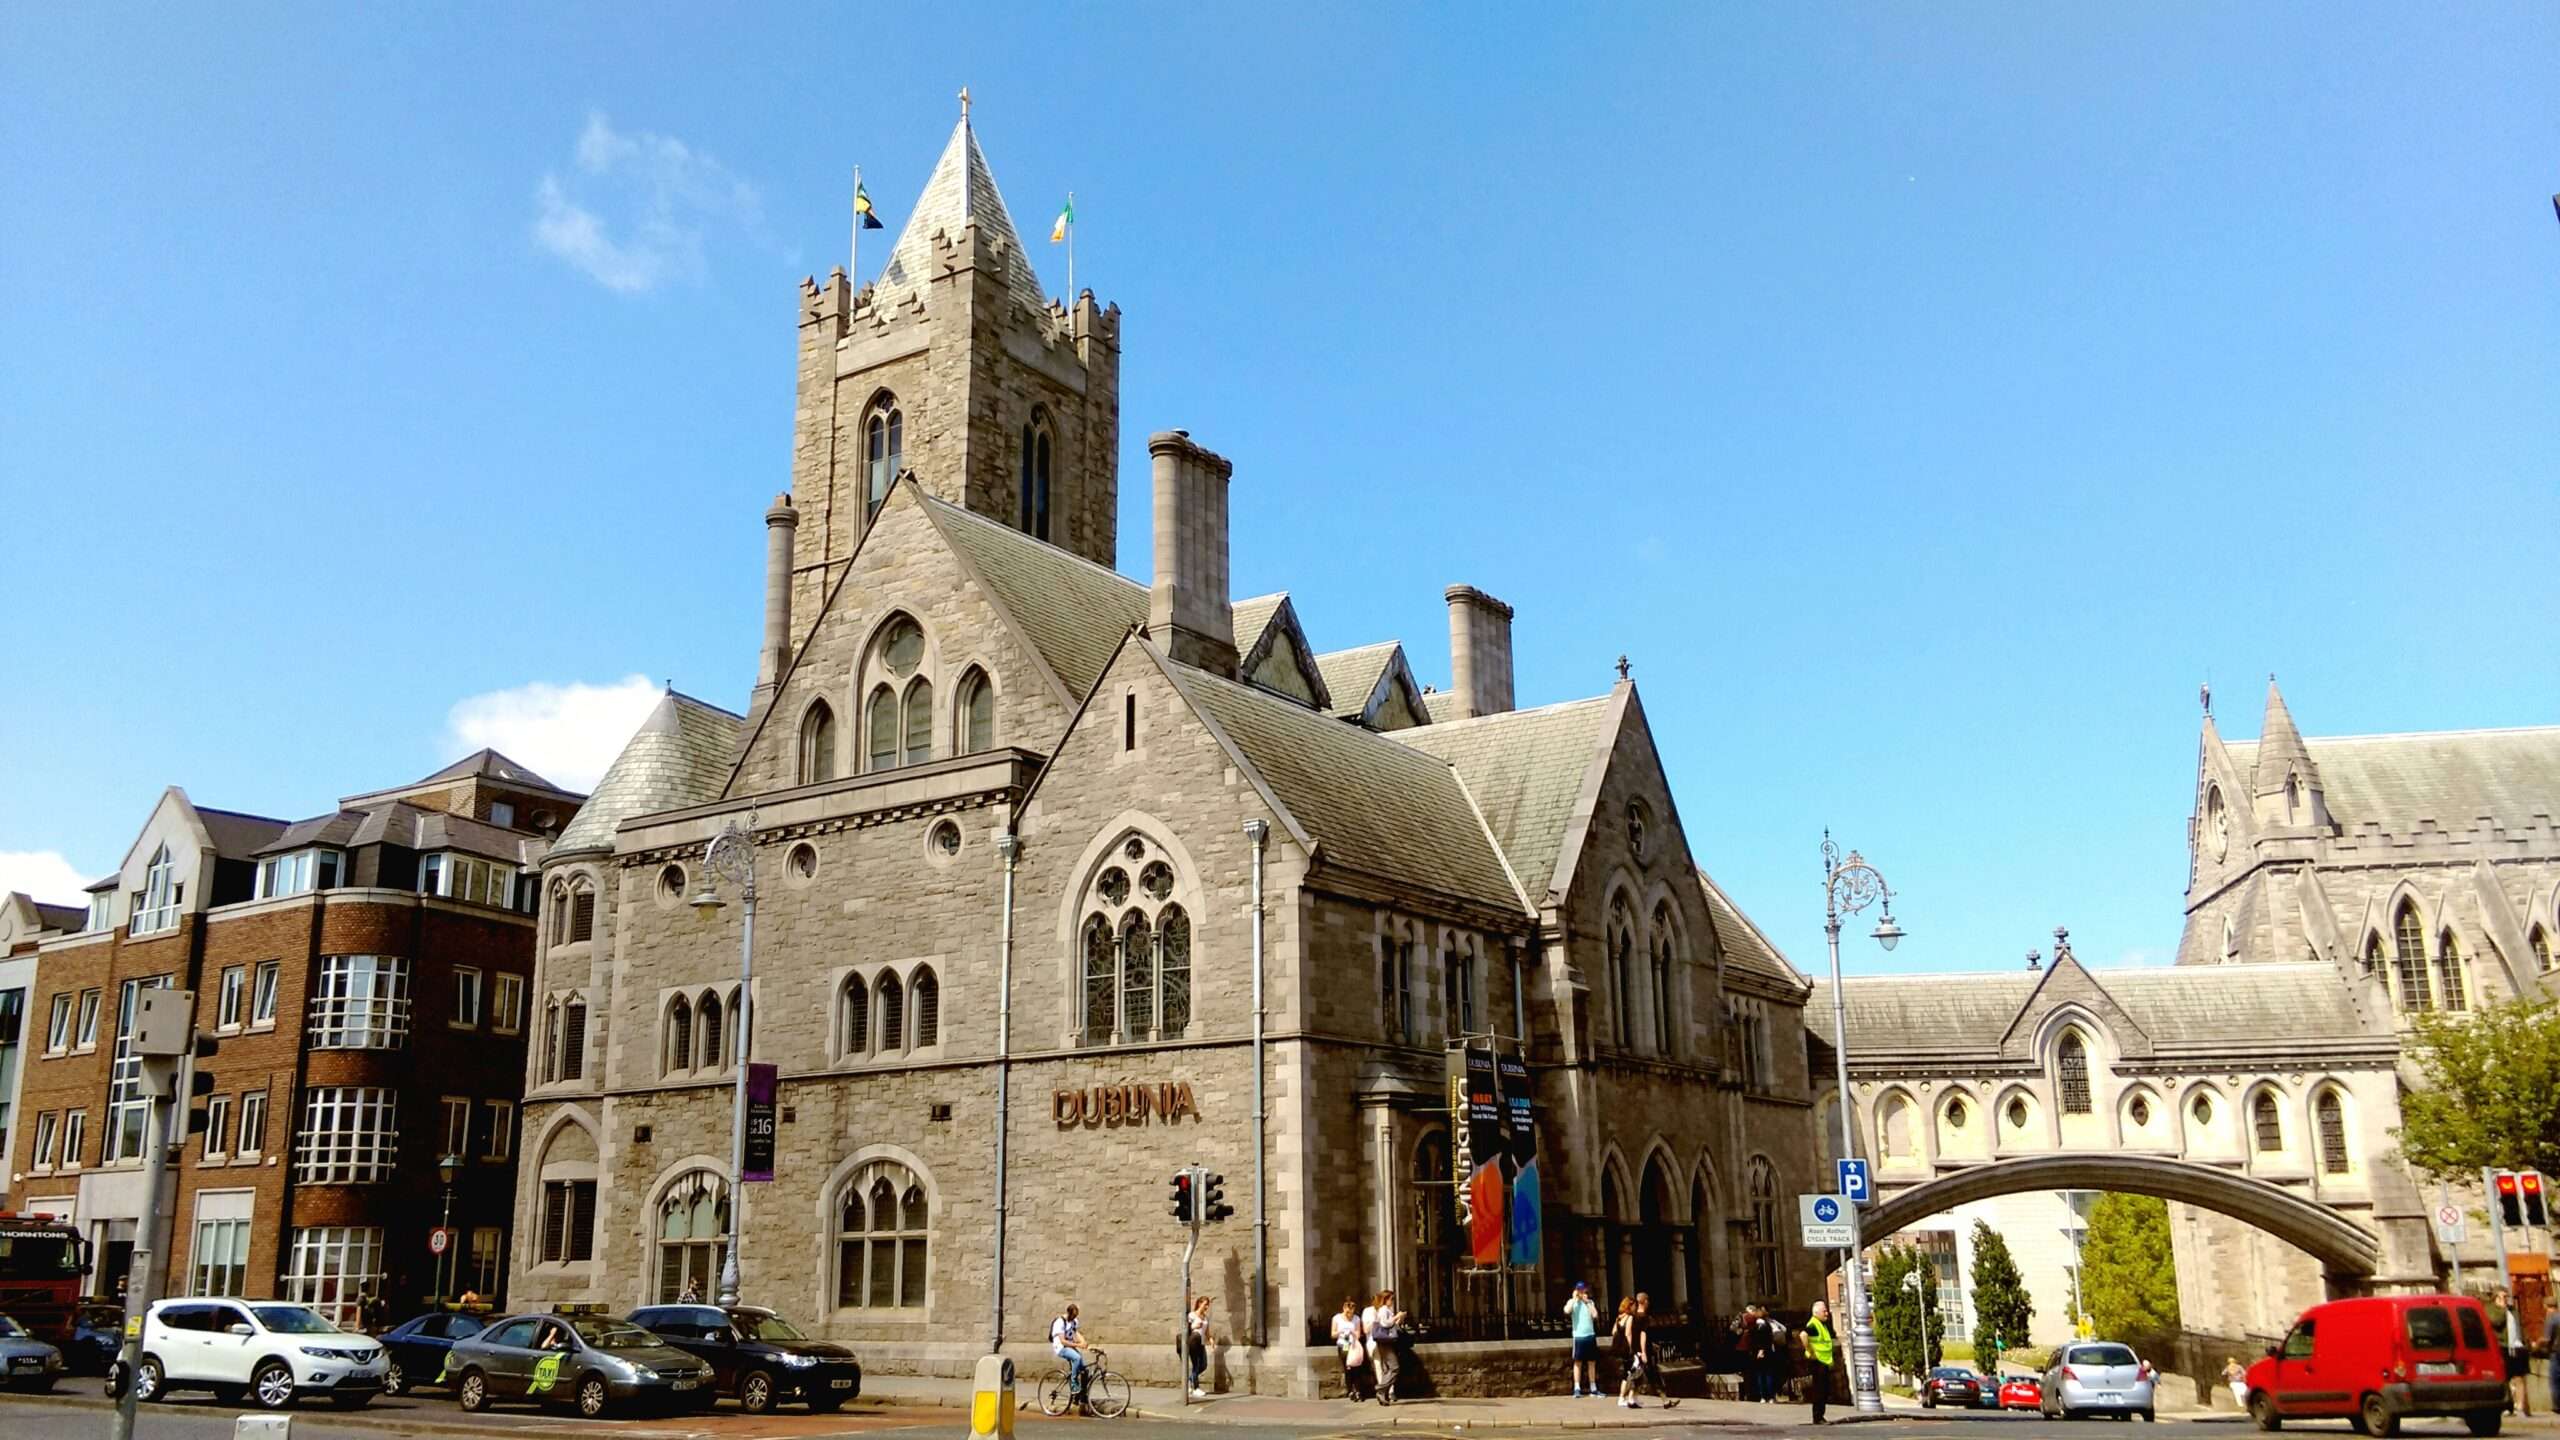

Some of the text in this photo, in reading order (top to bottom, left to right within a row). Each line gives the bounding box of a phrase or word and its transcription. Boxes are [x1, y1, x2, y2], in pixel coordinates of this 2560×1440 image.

[1050, 1081, 1201, 1127] DUBLINIA
[757, 1118, 772, 1135] 16
[1845, 1174, 1863, 1199] P
[0, 1231, 69, 1239] HORNTONS
[539, 1367, 555, 1377] TAXI
